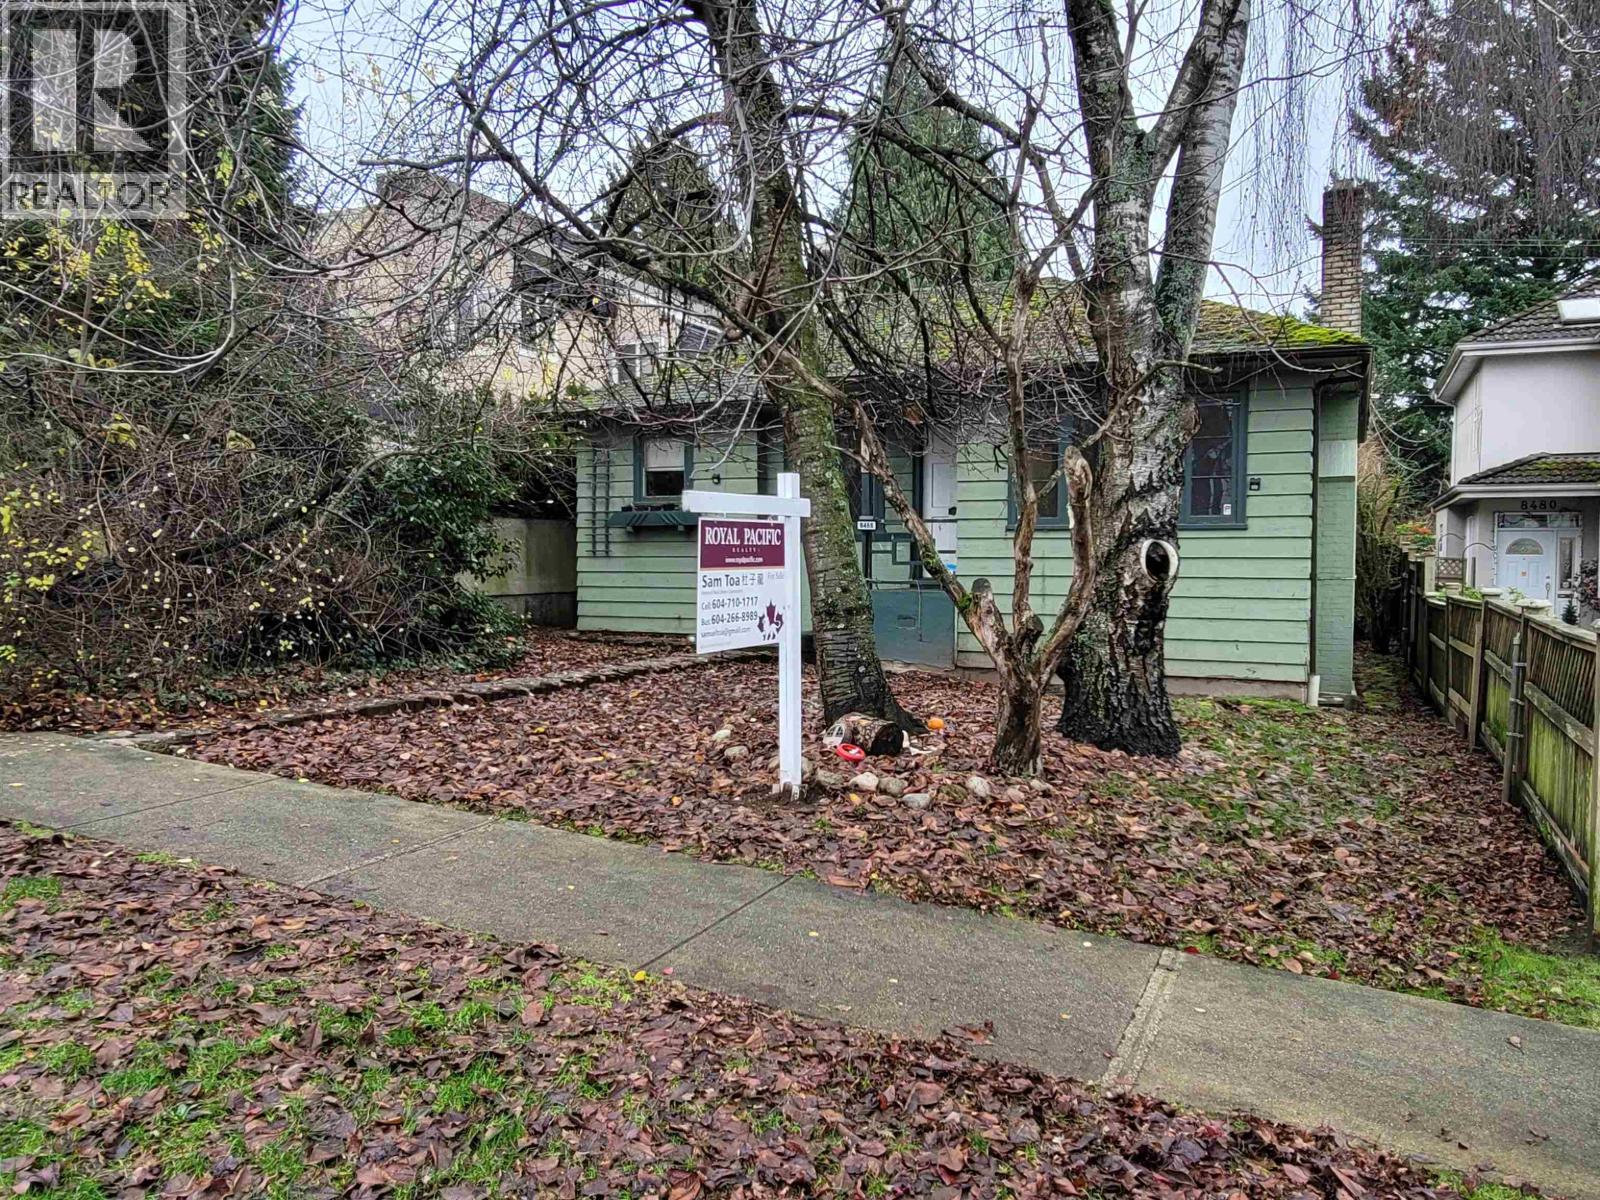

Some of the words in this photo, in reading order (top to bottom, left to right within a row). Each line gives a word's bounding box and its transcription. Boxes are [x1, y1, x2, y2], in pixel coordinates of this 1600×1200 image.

[1521, 500, 1557, 510] 8480
[705, 527, 740, 545] ROYAL
[744, 528, 781, 546] PACIFIC
[702, 574, 721, 588] Sam
[725, 574, 740, 587] Toa
[712, 597, 758, 609] 604-710-1717
[711, 611, 758, 625] 604-266-8989
